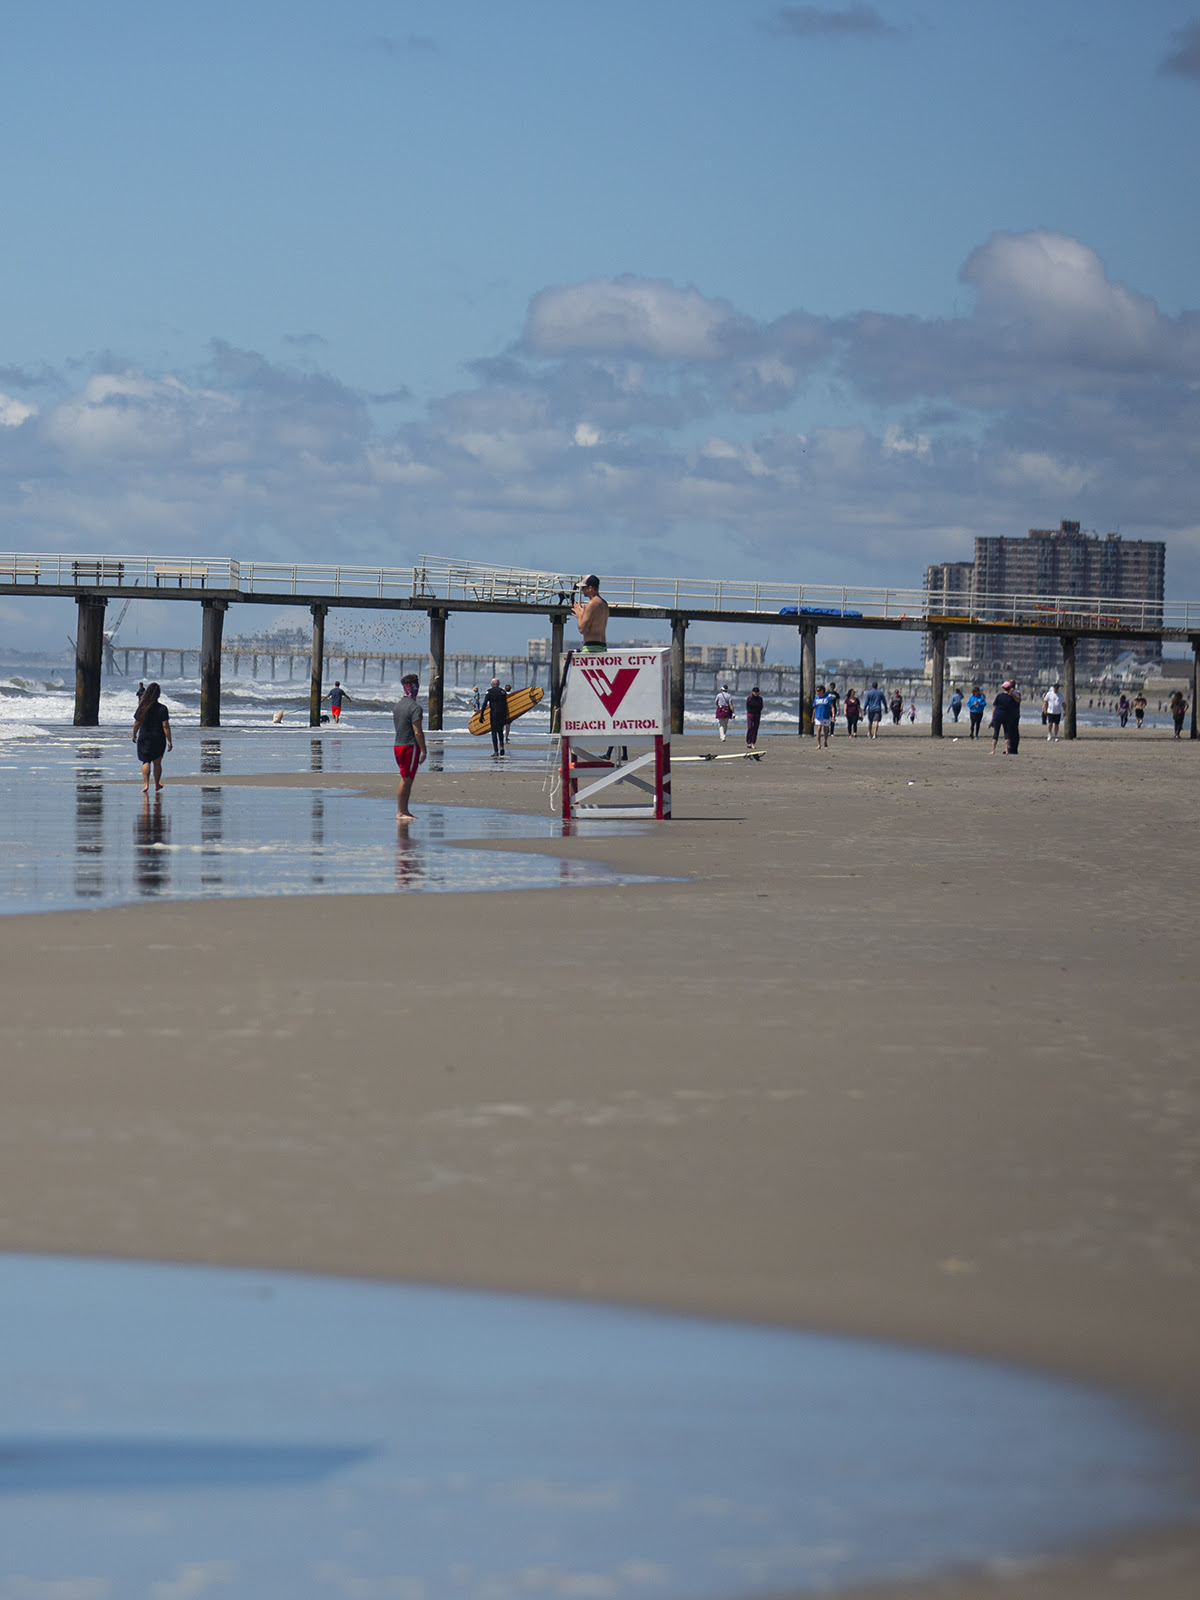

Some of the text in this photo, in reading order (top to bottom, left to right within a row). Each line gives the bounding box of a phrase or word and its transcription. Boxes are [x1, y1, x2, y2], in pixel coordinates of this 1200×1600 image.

[564, 656, 622, 666] ENTNOR
[628, 655, 657, 665] CITY
[565, 721, 606, 730] BEACH
[612, 719, 659, 729] PATROL
